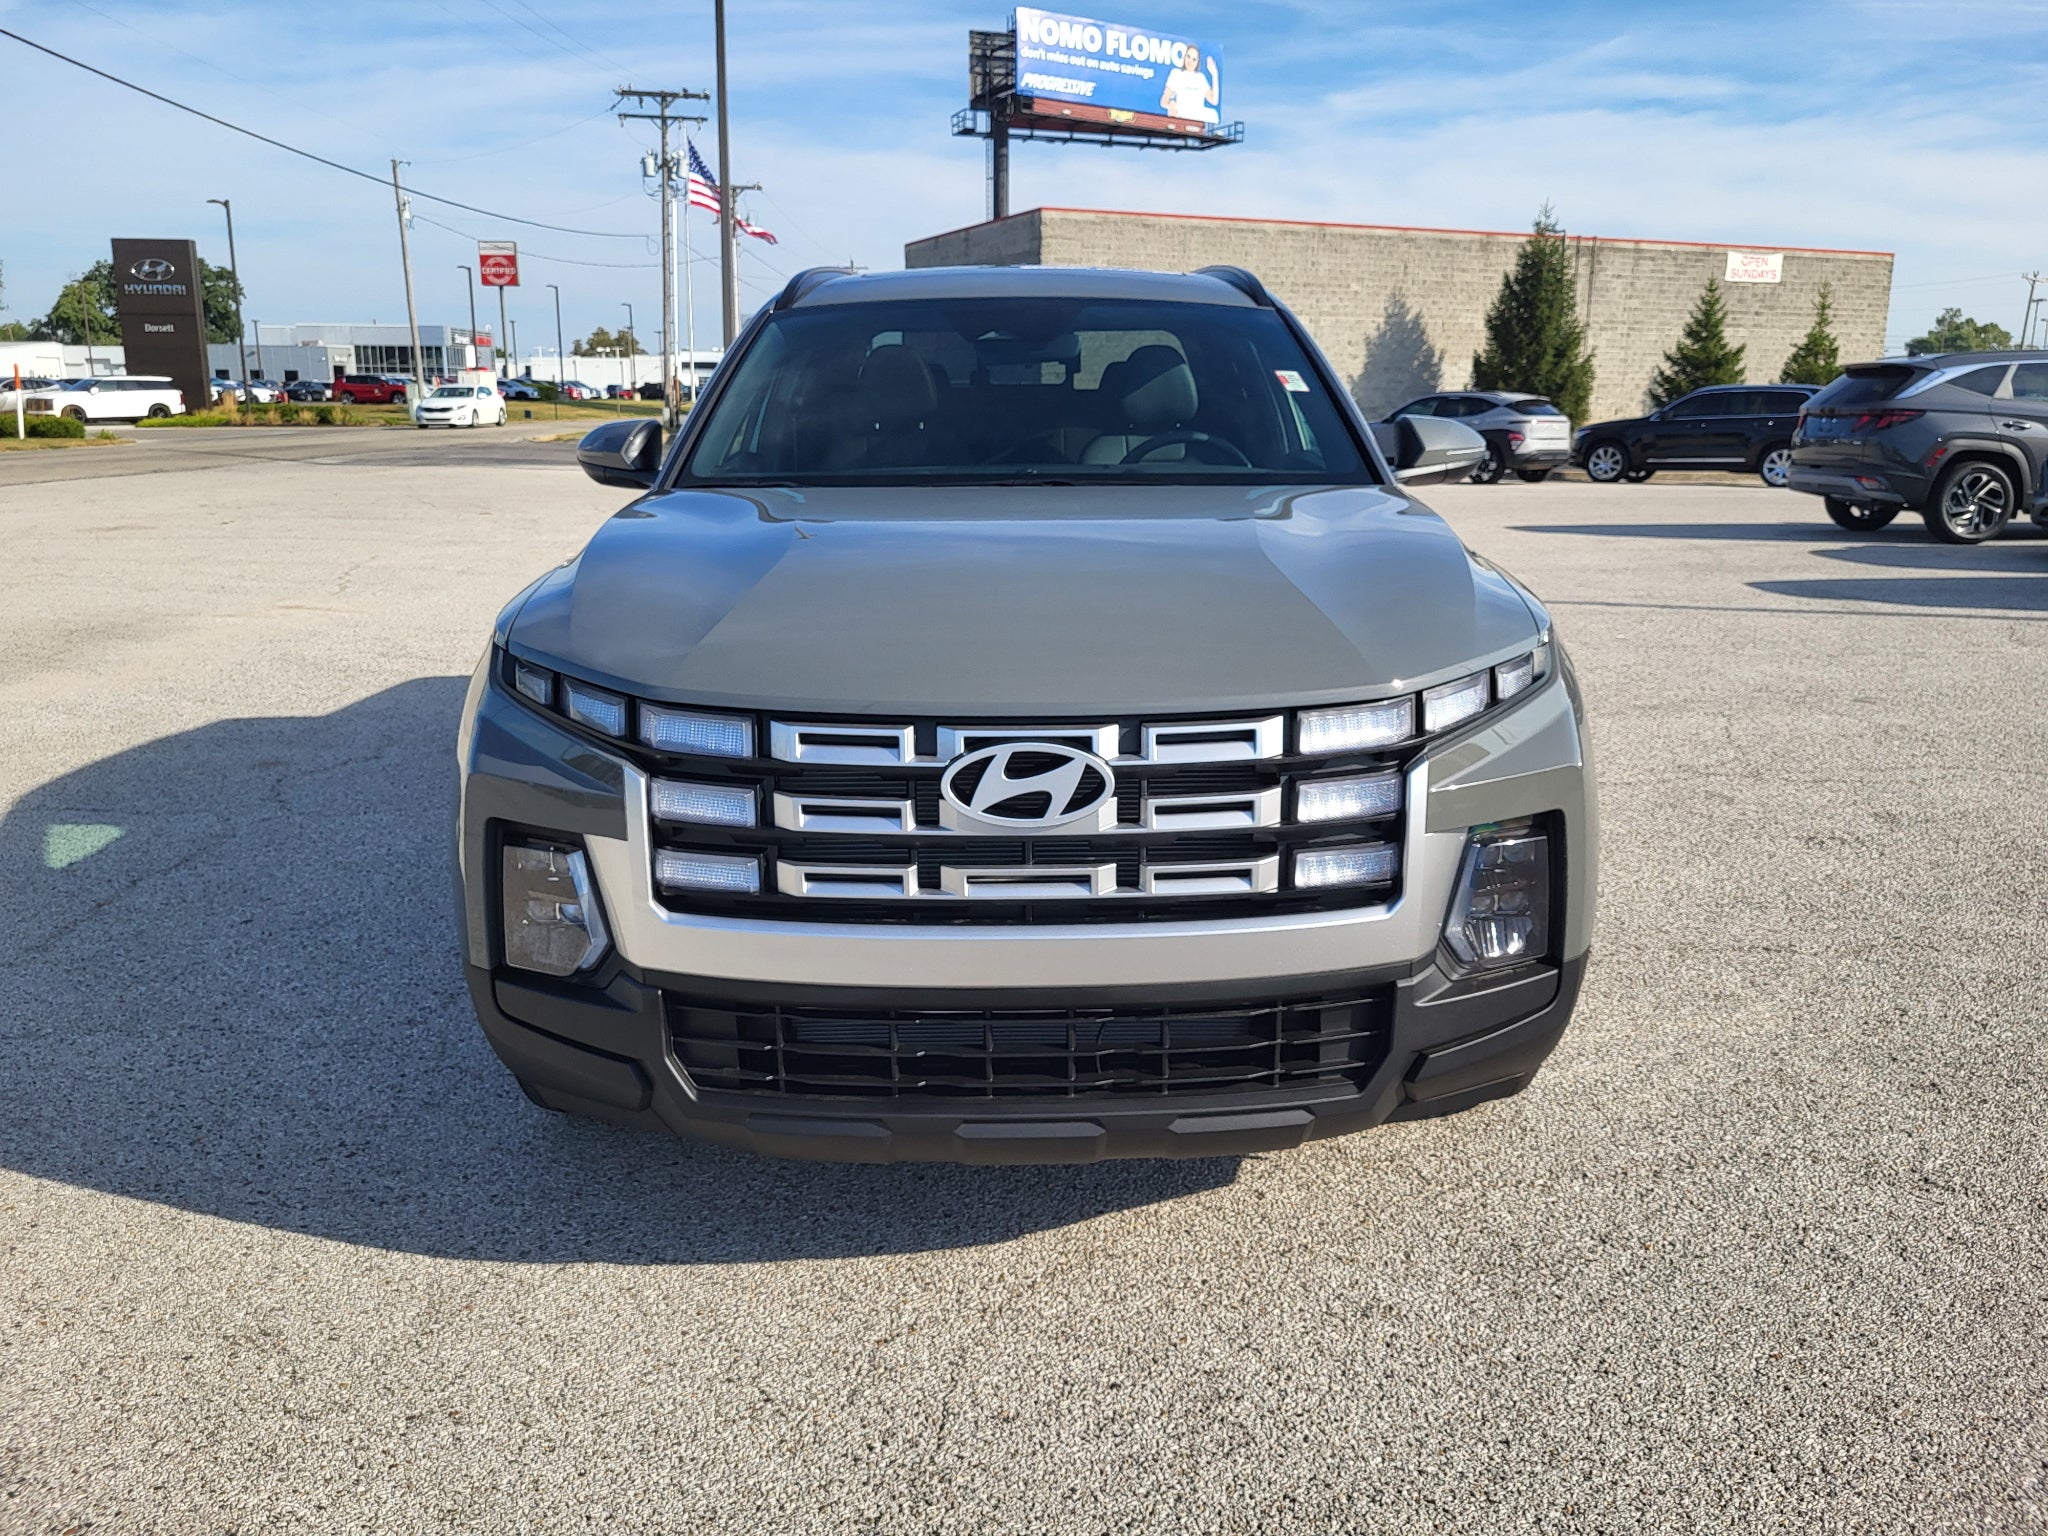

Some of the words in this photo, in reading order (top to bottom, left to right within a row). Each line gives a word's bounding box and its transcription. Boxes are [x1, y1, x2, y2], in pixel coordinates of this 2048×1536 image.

[1020, 14, 1103, 53] NOMO
[1106, 29, 1187, 68] FLOMO
[1020, 46, 1046, 60] don't
[1046, 51, 1069, 64] miss
[1069, 55, 1086, 67] out
[1086, 59, 1099, 69] on
[1099, 59, 1120, 72] auto
[1120, 64, 1155, 79] savings
[1021, 72, 1097, 97] PROGRESSIVE
[1741, 255, 1769, 267] OPEN
[1730, 268, 1777, 280] SUNDAYS
[124, 284, 187, 296] HYUNDAI
[144, 323, 175, 333] Dorsett
